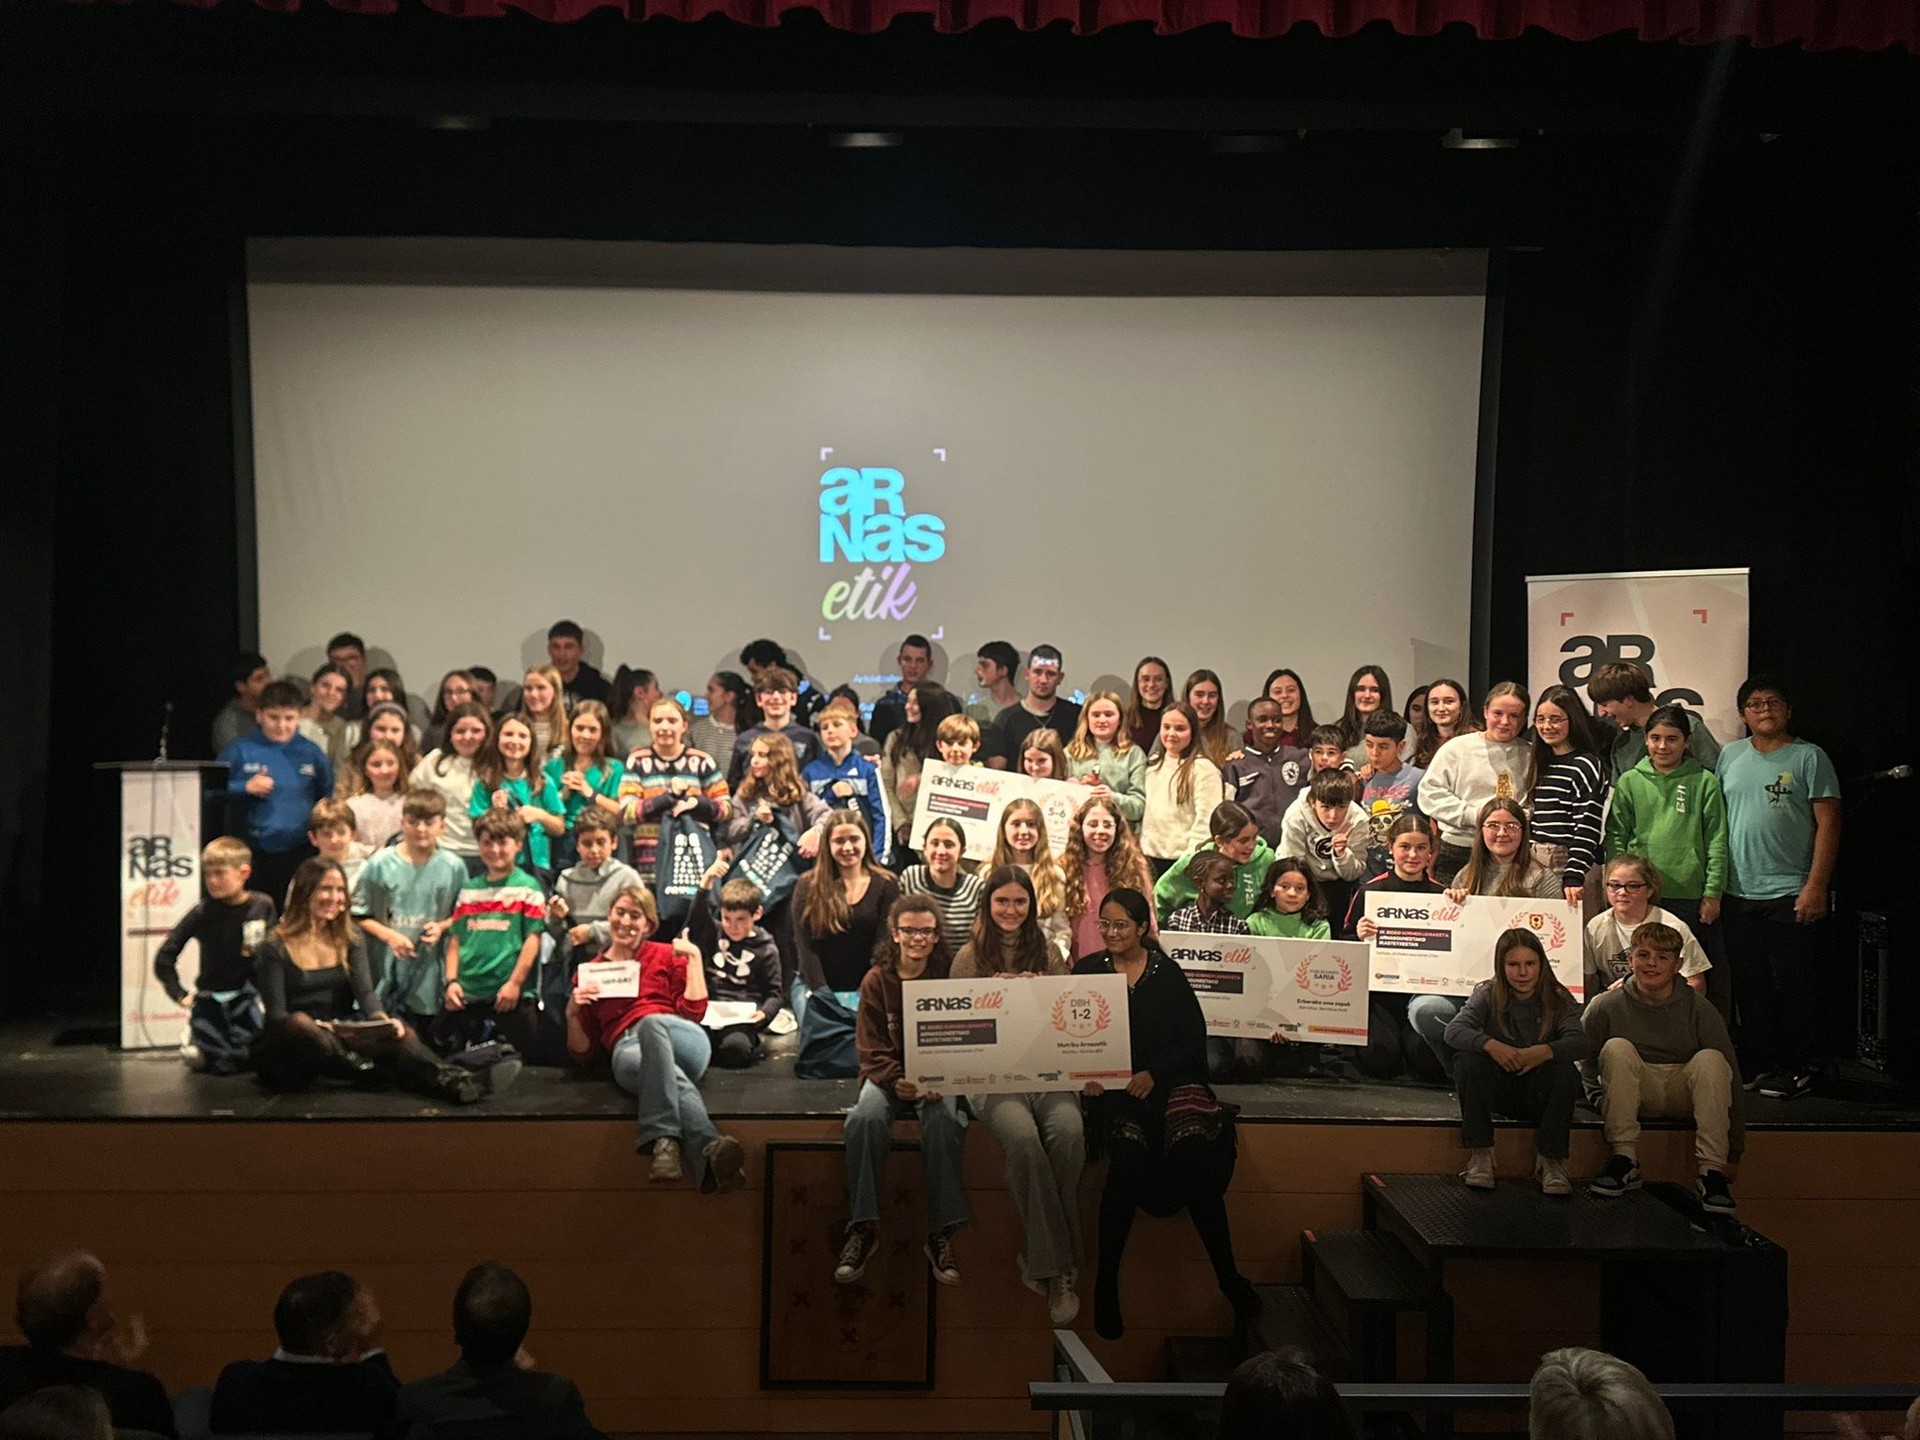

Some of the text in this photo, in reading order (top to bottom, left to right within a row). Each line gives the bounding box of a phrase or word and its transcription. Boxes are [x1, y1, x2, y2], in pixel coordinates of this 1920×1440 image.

[819, 467, 905, 516] aR
[819, 513, 946, 563] Nas
[821, 562, 917, 621] etik
[1048, 806, 1066, 818] 5-6
[128, 855, 193, 879] Nas
[1431, 906, 1460, 921] etik
[1224, 947, 1251, 964] etik
[974, 991, 1003, 1009] etik
[1070, 999, 1091, 1008] DBH
[1071, 1008, 1091, 1020] 1-2
